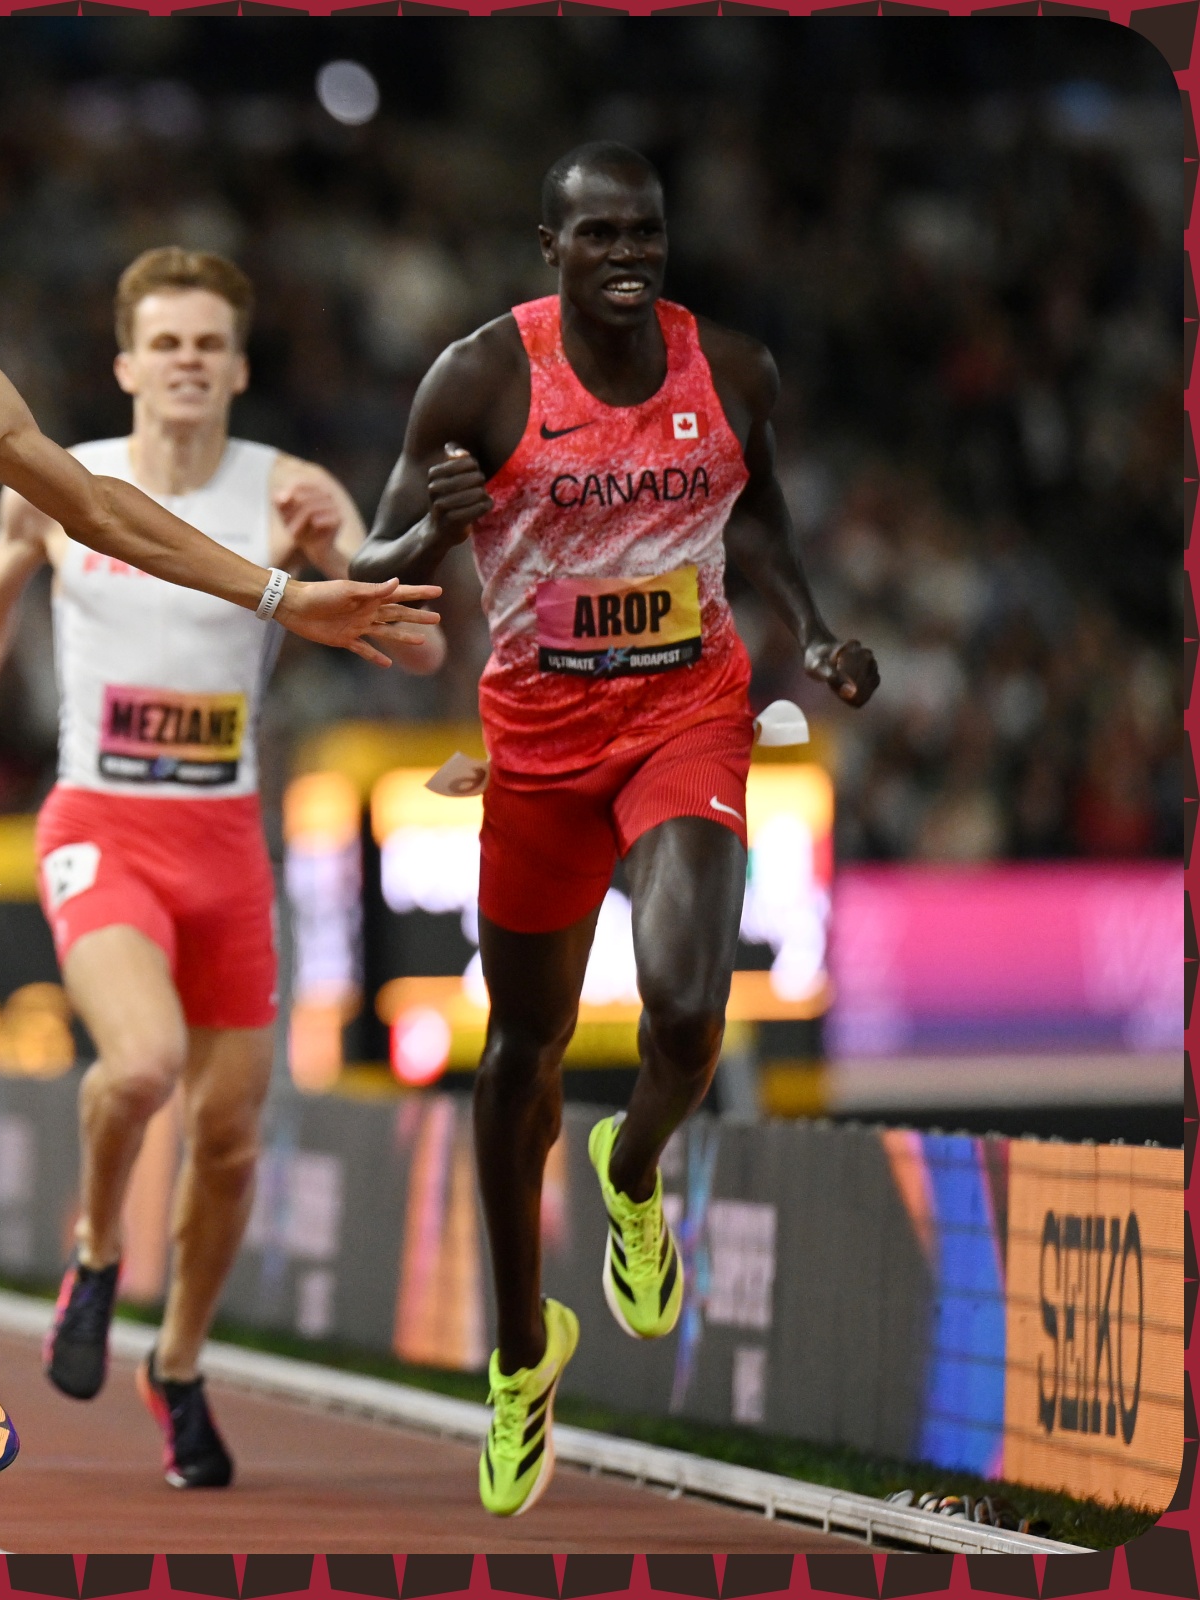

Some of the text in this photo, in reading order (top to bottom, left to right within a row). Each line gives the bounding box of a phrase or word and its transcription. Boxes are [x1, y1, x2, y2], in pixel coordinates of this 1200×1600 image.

[549, 465, 710, 508] CANADA
[572, 589, 672, 639] AROP
[548, 655, 595, 671] ULTIMATE
[629, 648, 680, 668] BUDAPEST
[111, 700, 237, 746] MEZIANE
[1037, 1208, 1143, 1446] SEIKO
